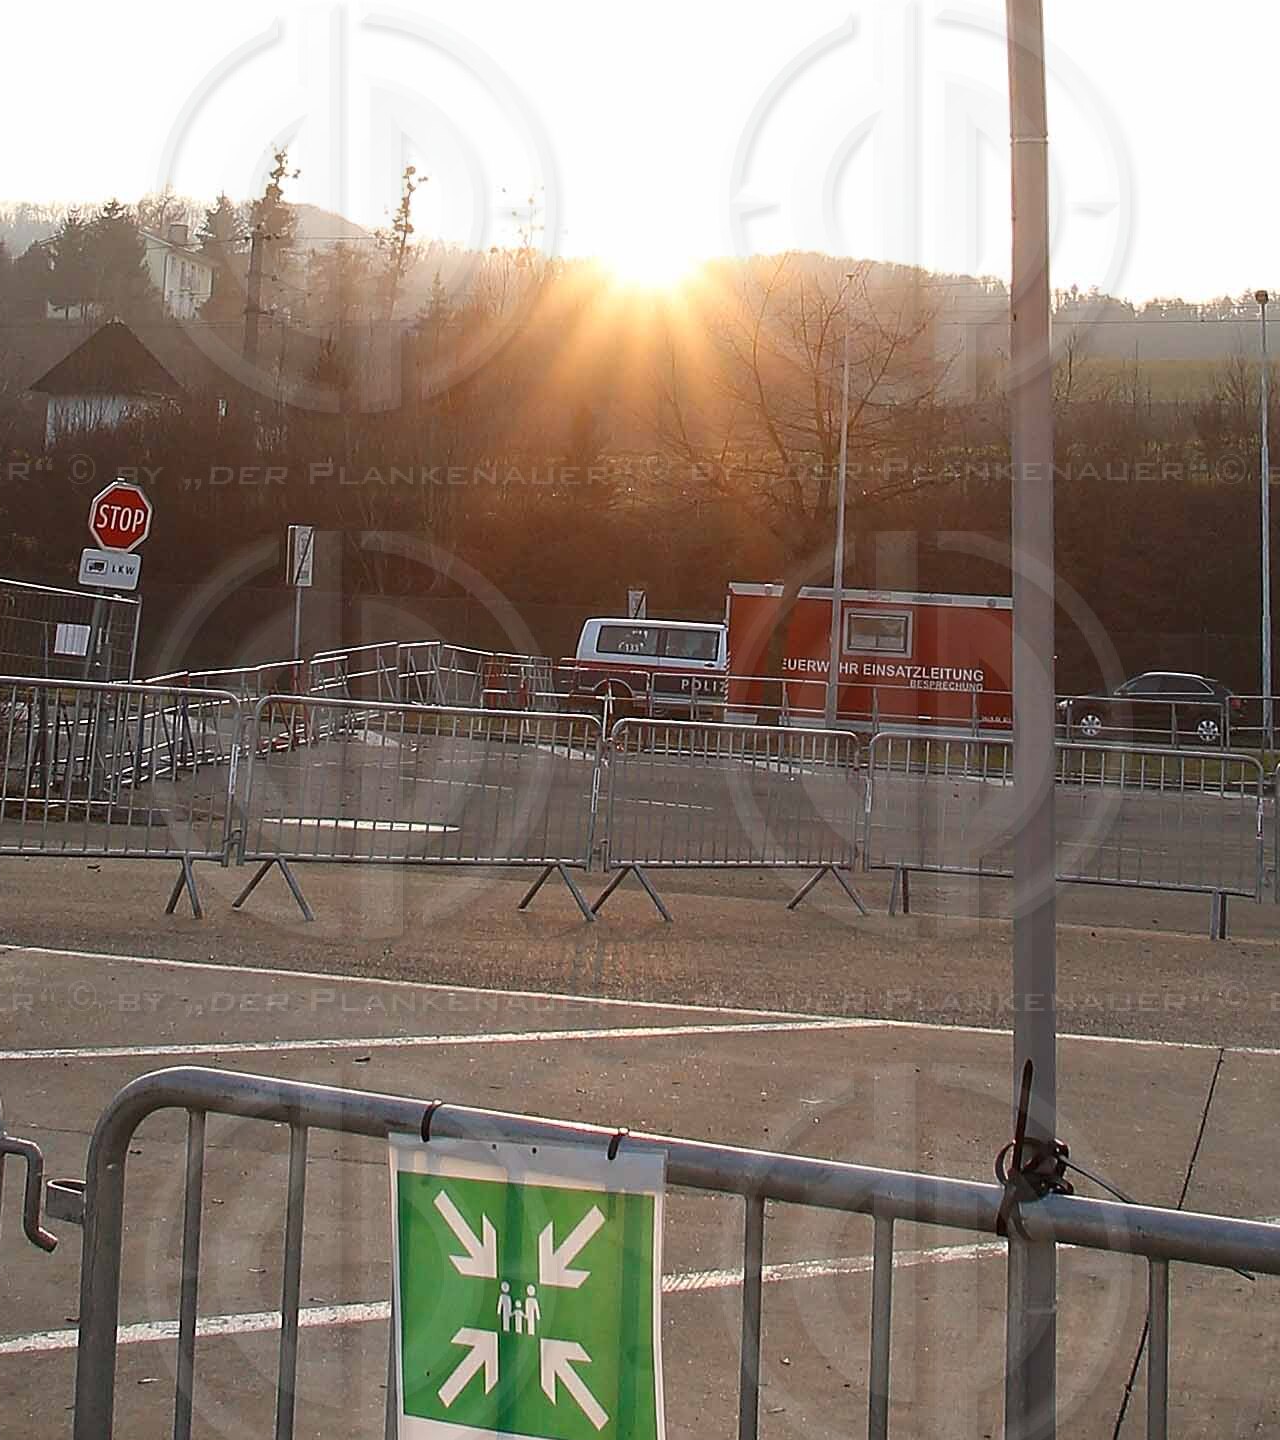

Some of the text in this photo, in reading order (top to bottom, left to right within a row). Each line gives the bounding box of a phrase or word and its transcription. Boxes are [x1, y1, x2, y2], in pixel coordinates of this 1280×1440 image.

[97, 504, 144, 533] STOP
[111, 563, 136, 576] LKW
[863, 663, 984, 682] EINSATZLEITUNG
[910, 679, 983, 692] BESPRECHUNG
